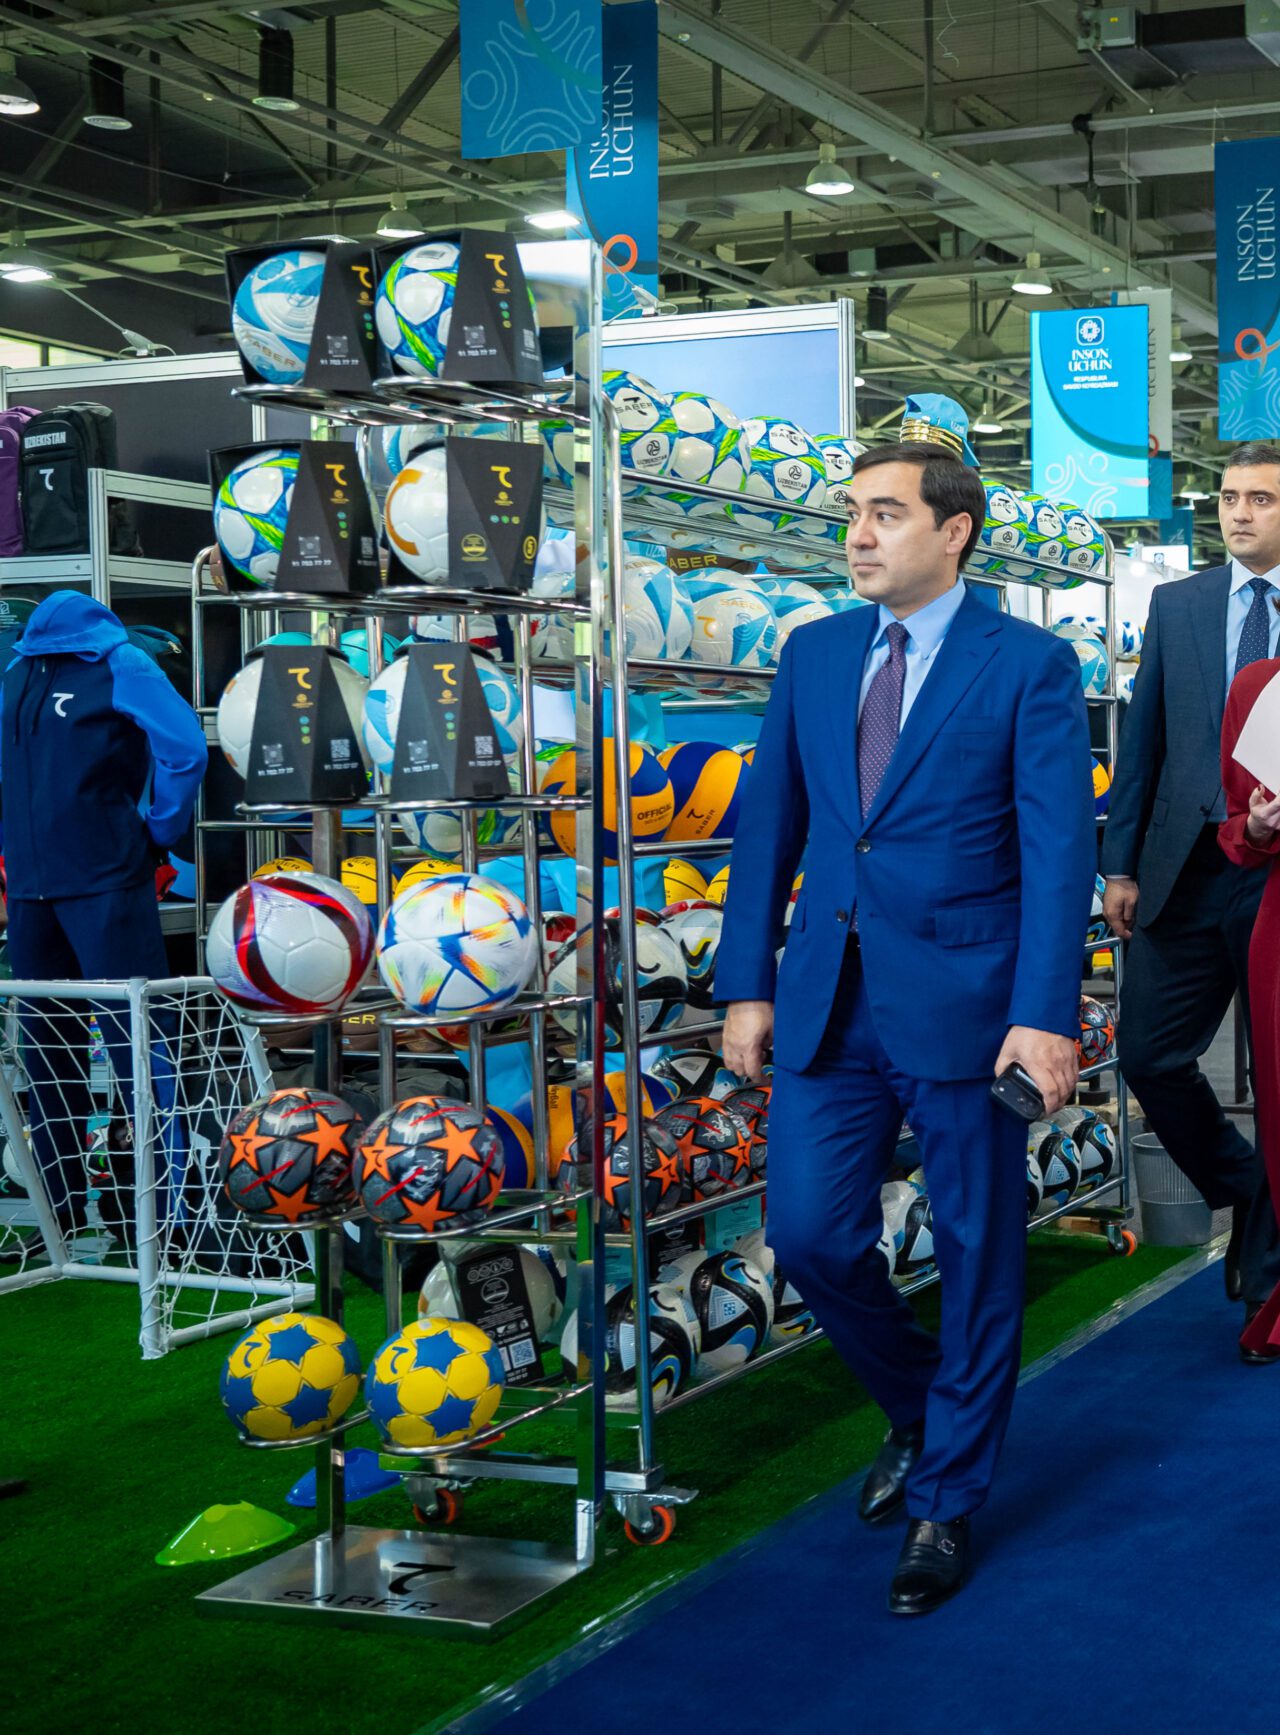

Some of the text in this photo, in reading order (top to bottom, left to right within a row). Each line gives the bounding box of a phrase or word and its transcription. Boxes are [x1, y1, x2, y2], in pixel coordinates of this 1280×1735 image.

[612, 64, 634, 178] UCHUN
[1236, 203, 1255, 282] INSON
[1256, 187, 1276, 280] UCHUN
[1071, 348, 1109, 361] INSON
[1068, 359, 1113, 372] UCHUN
[23, 431, 67, 450] UZBEKISTAN
[667, 554, 719, 569] ABER
